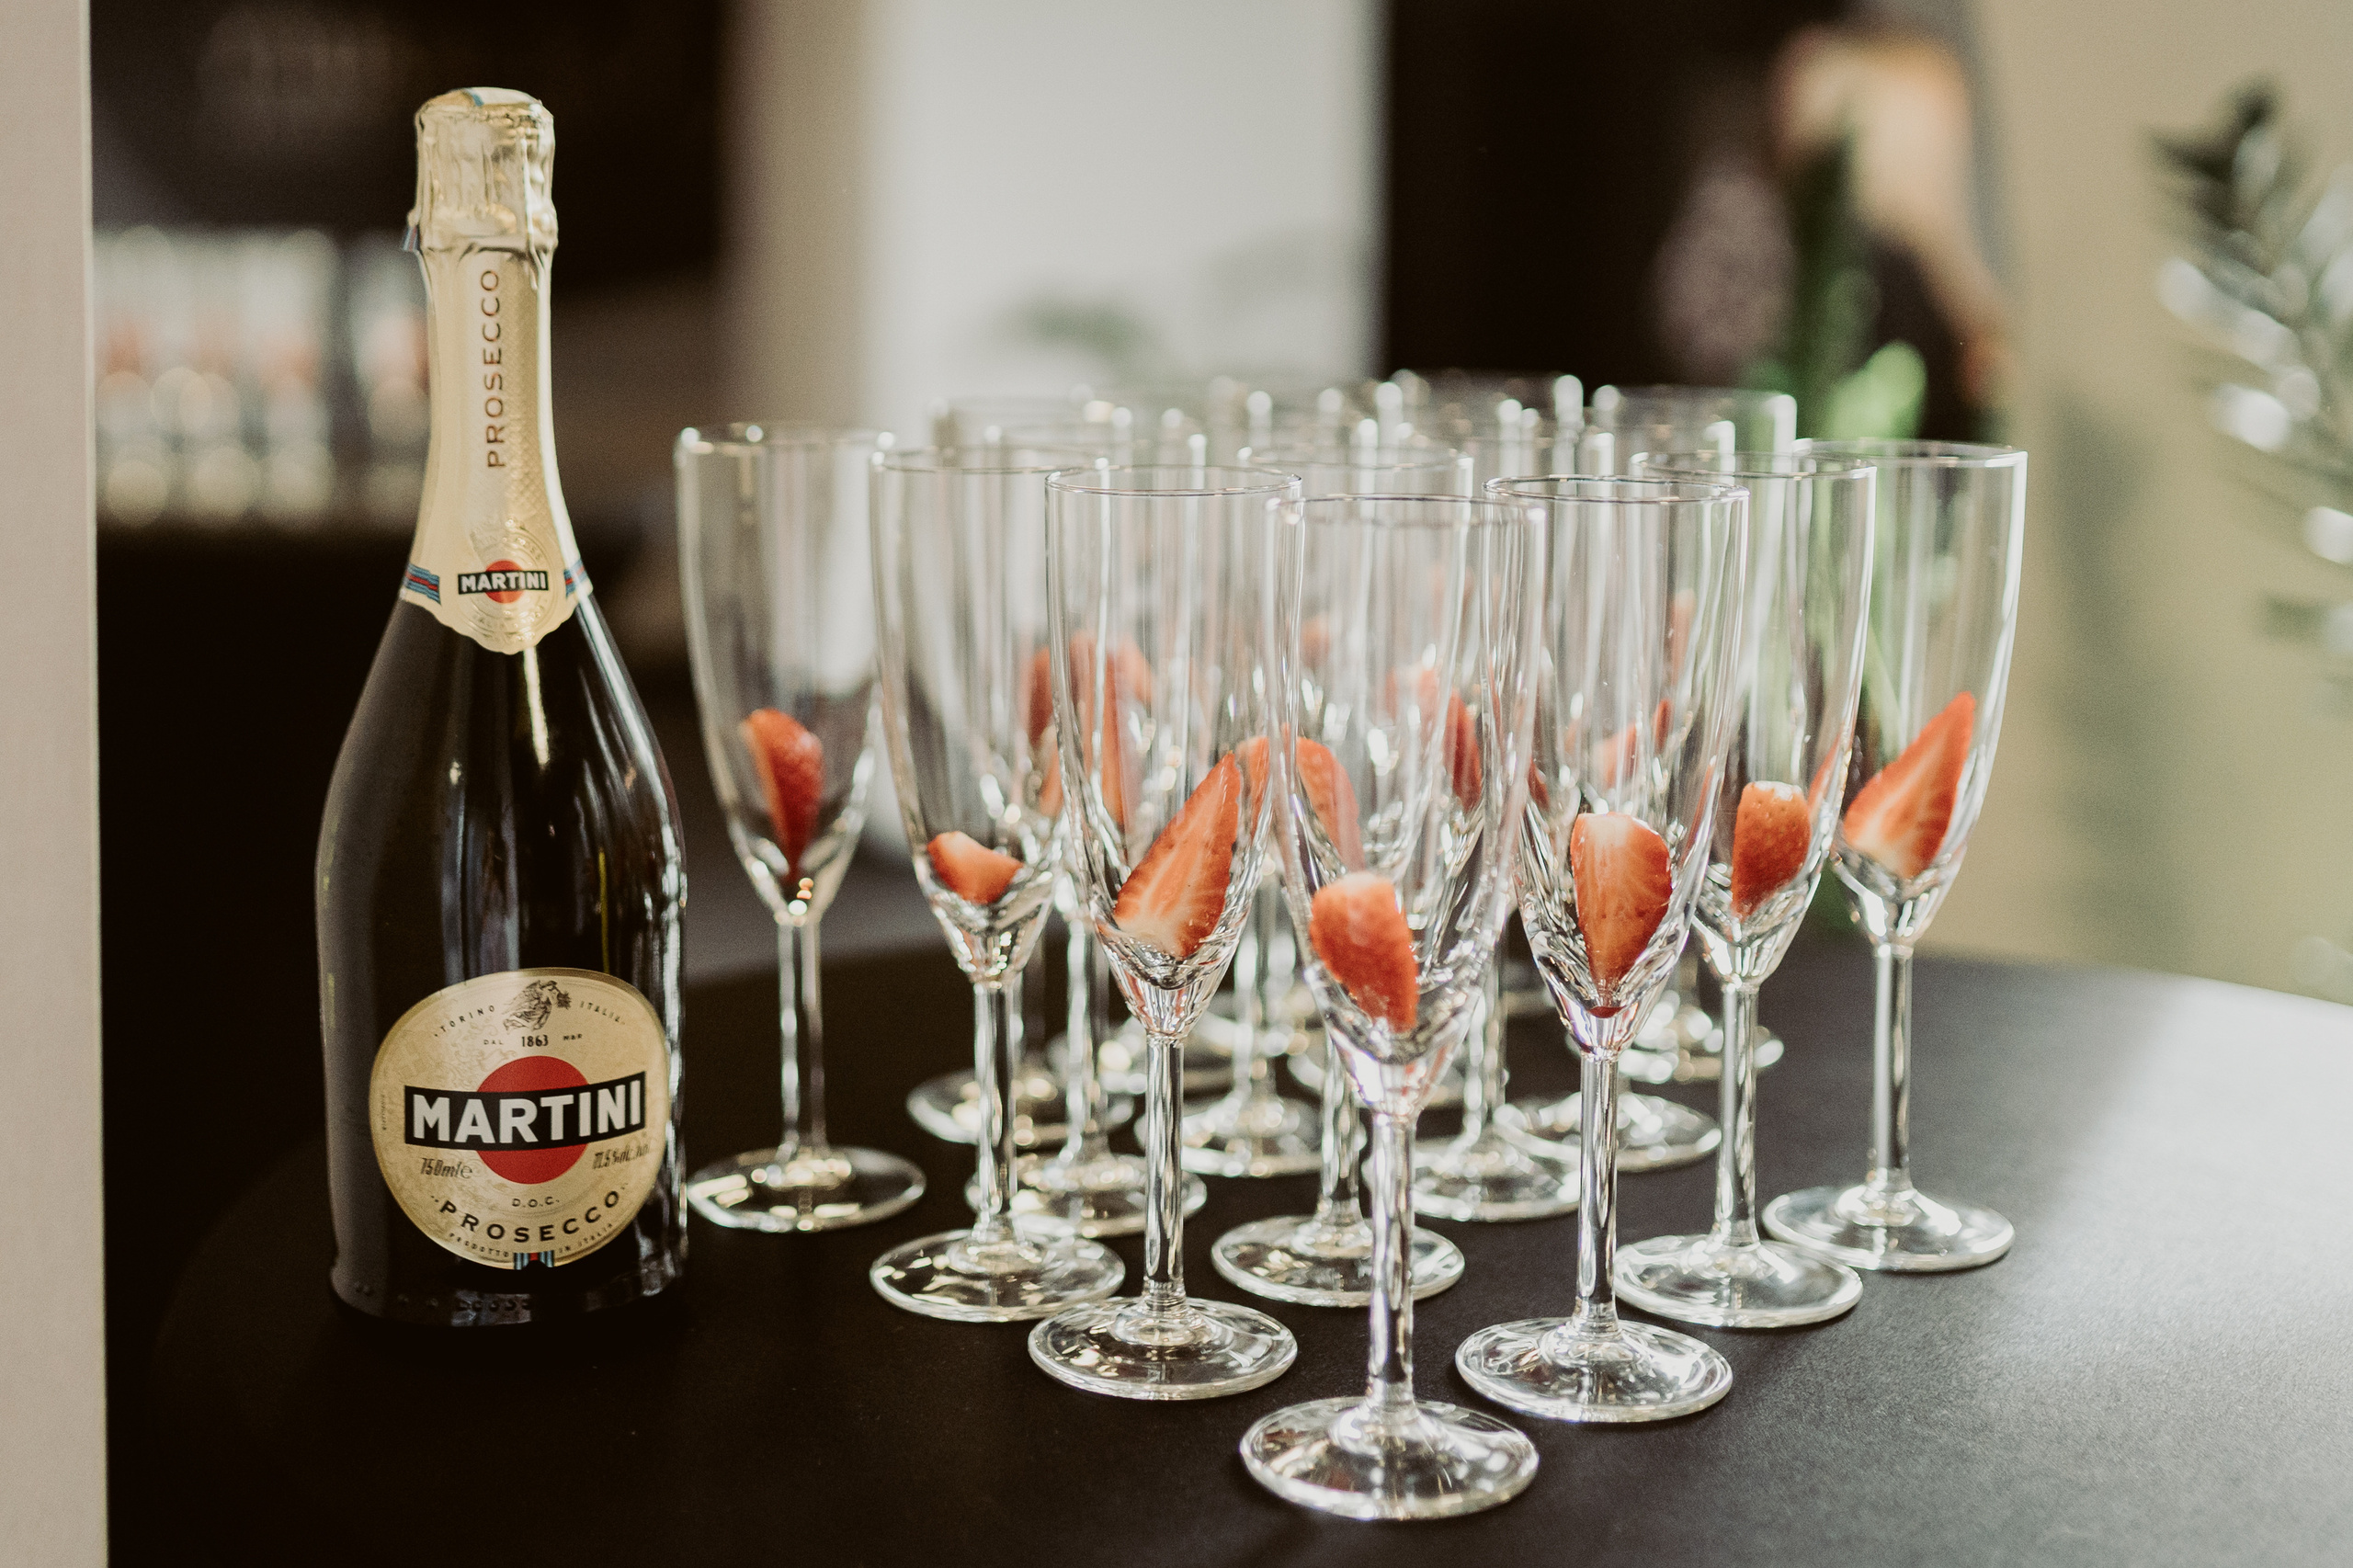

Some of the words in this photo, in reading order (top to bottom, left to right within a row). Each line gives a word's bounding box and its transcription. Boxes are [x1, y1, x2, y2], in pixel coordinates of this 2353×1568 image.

[481, 270, 506, 468] PROSECCO
[460, 571, 547, 593] MARTINI
[440, 1005, 495, 1032] TORINO
[521, 1034, 549, 1047] 1863
[413, 1079, 642, 1144] MARTINI
[511, 1196, 561, 1209] D.O.C.
[438, 1190, 620, 1244] PROSECCO
